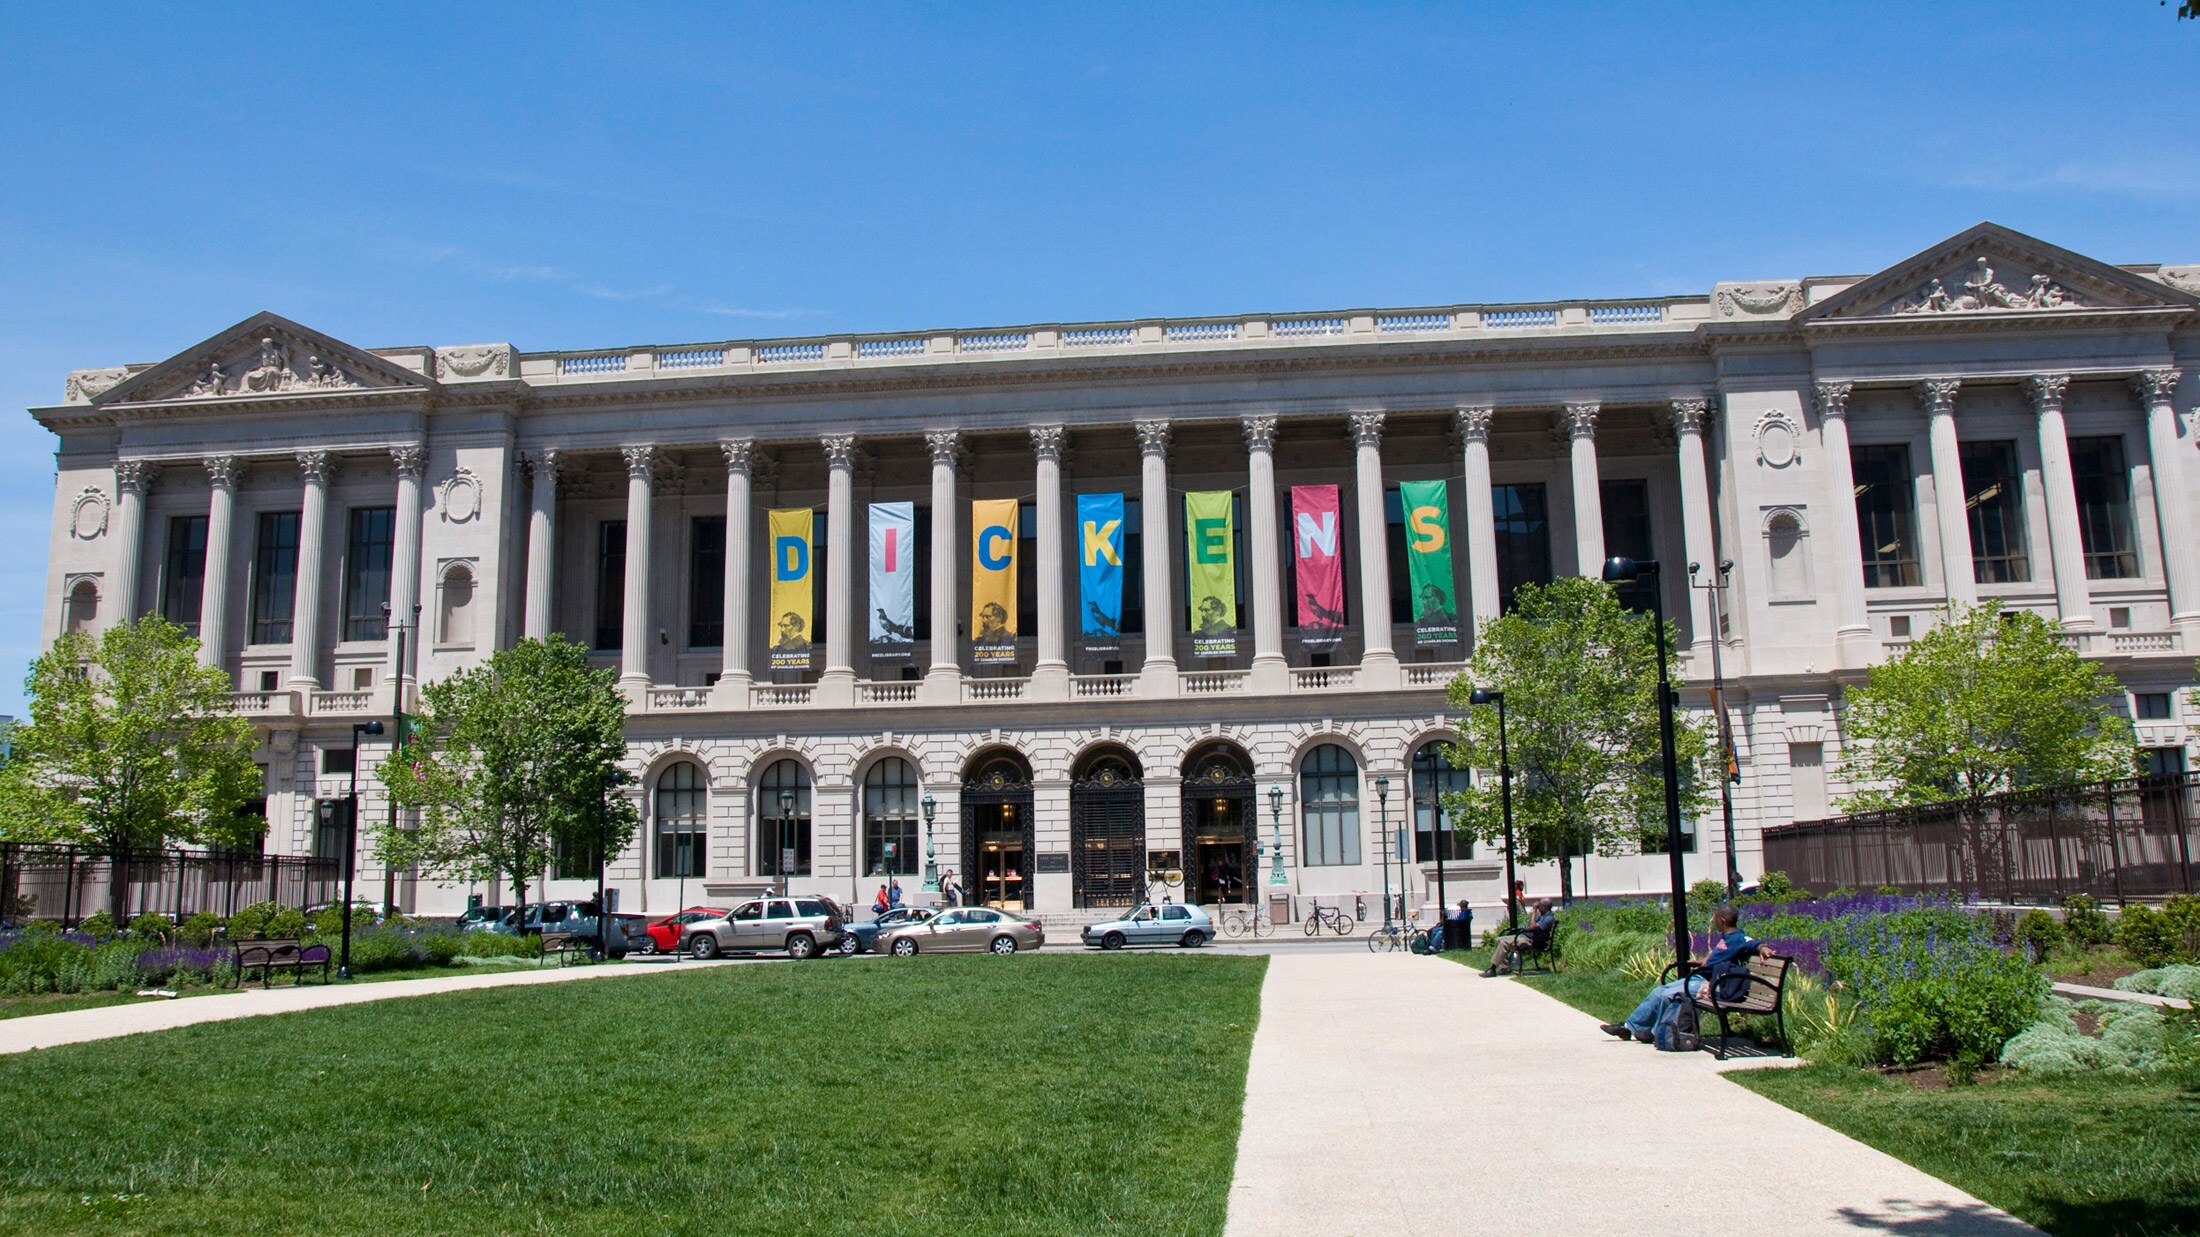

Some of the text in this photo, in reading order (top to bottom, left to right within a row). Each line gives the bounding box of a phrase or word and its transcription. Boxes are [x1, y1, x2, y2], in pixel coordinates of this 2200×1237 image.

[885, 528, 897, 573] I
[978, 525, 1013, 571] C
[1083, 518, 1123, 567] K
[1195, 517, 1228, 564] E
[1297, 511, 1336, 559] N
[1410, 505, 1446, 553] S
[775, 535, 809, 582] D
